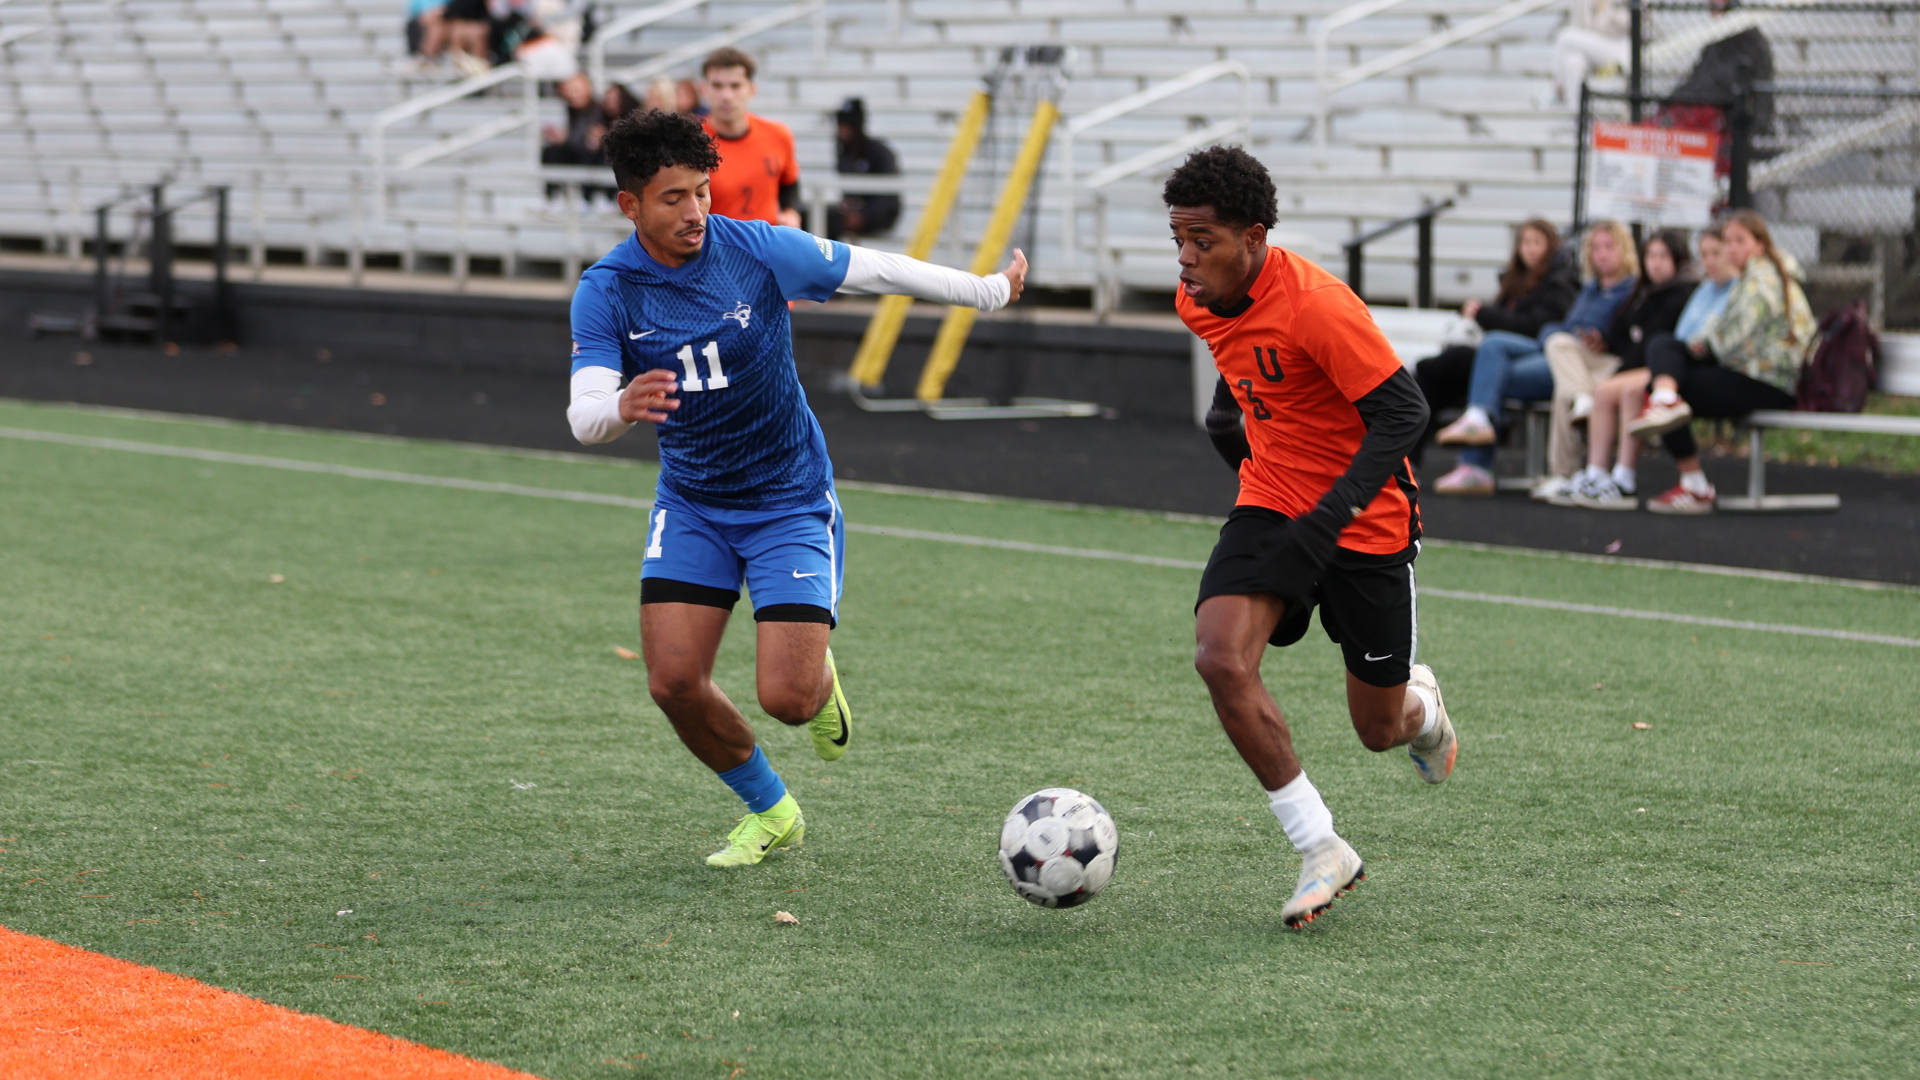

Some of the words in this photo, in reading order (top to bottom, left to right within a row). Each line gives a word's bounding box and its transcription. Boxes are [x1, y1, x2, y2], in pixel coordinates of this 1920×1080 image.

[764, 156, 780, 177] U
[741, 186, 754, 215] 2
[676, 341, 730, 392] 11
[1253, 346, 1285, 382] U
[643, 509, 668, 559] 1
